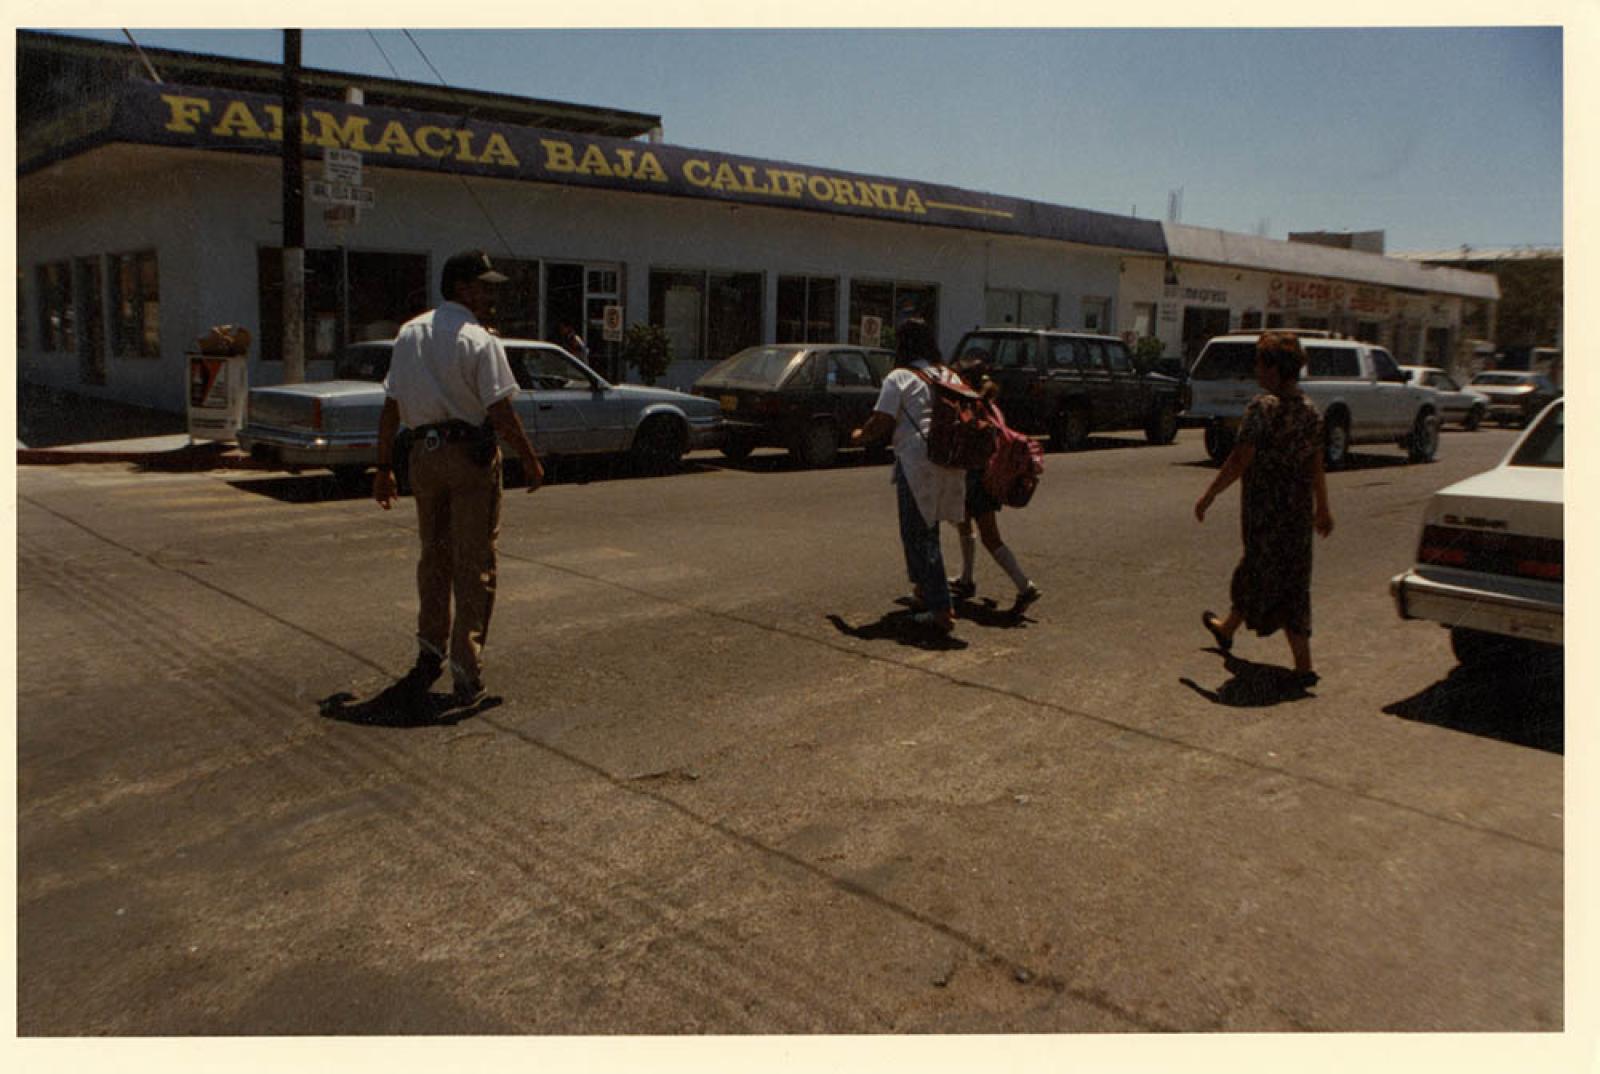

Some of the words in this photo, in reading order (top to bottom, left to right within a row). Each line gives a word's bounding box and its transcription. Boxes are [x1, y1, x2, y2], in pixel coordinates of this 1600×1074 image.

[161, 95, 519, 167] FARMACIA
[540, 139, 667, 182] BAJA
[682, 159, 926, 214] CALIFORNIA
